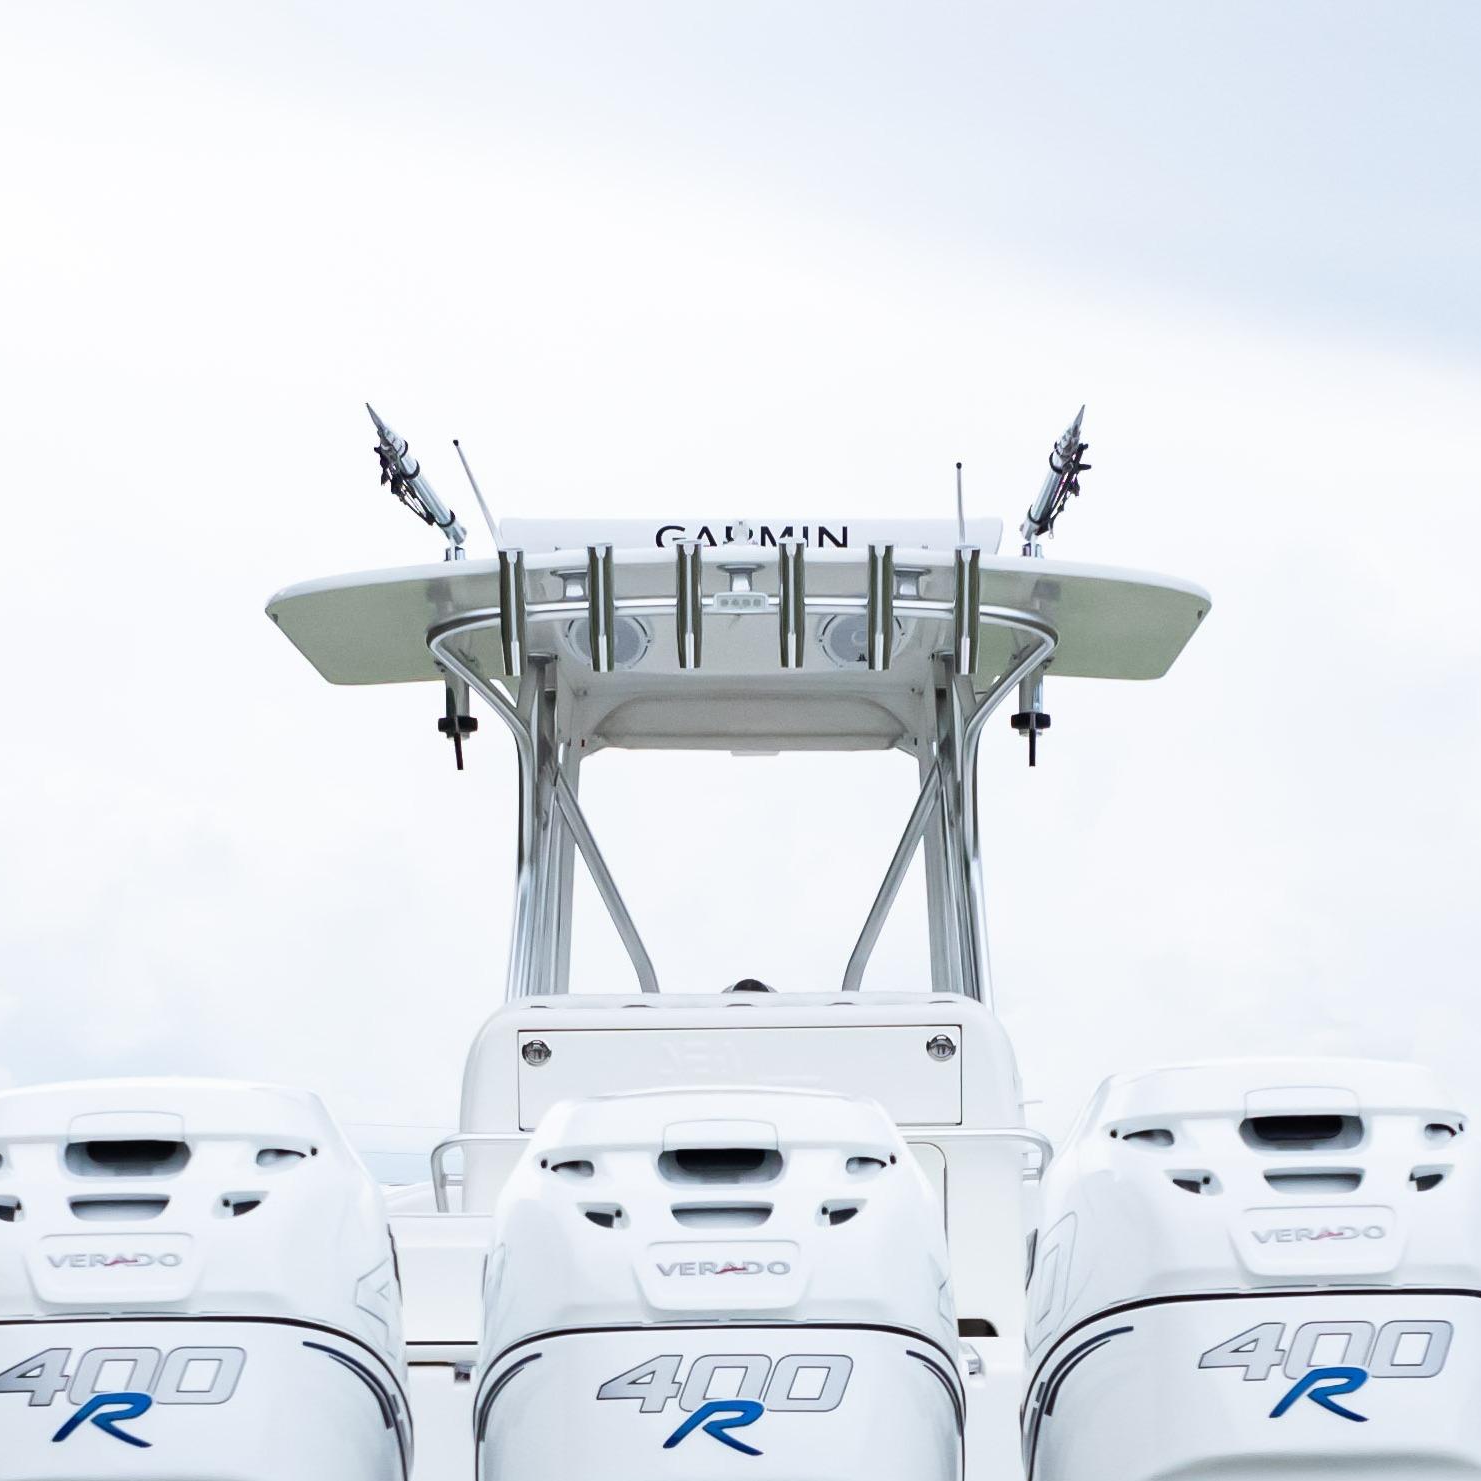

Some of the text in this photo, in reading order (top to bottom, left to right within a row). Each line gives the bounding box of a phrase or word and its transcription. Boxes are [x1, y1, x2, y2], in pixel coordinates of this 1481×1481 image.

[46, 1253, 182, 1268] VERADO
[1251, 1225, 1386, 1244] VERADO
[655, 1261, 791, 1277] VERADO
[1198, 1319, 1454, 1381] 400
[596, 1354, 854, 1413] 400
[1269, 1366, 1369, 1423] R
[51, 1391, 153, 1448] R
[662, 1400, 764, 1456] R
